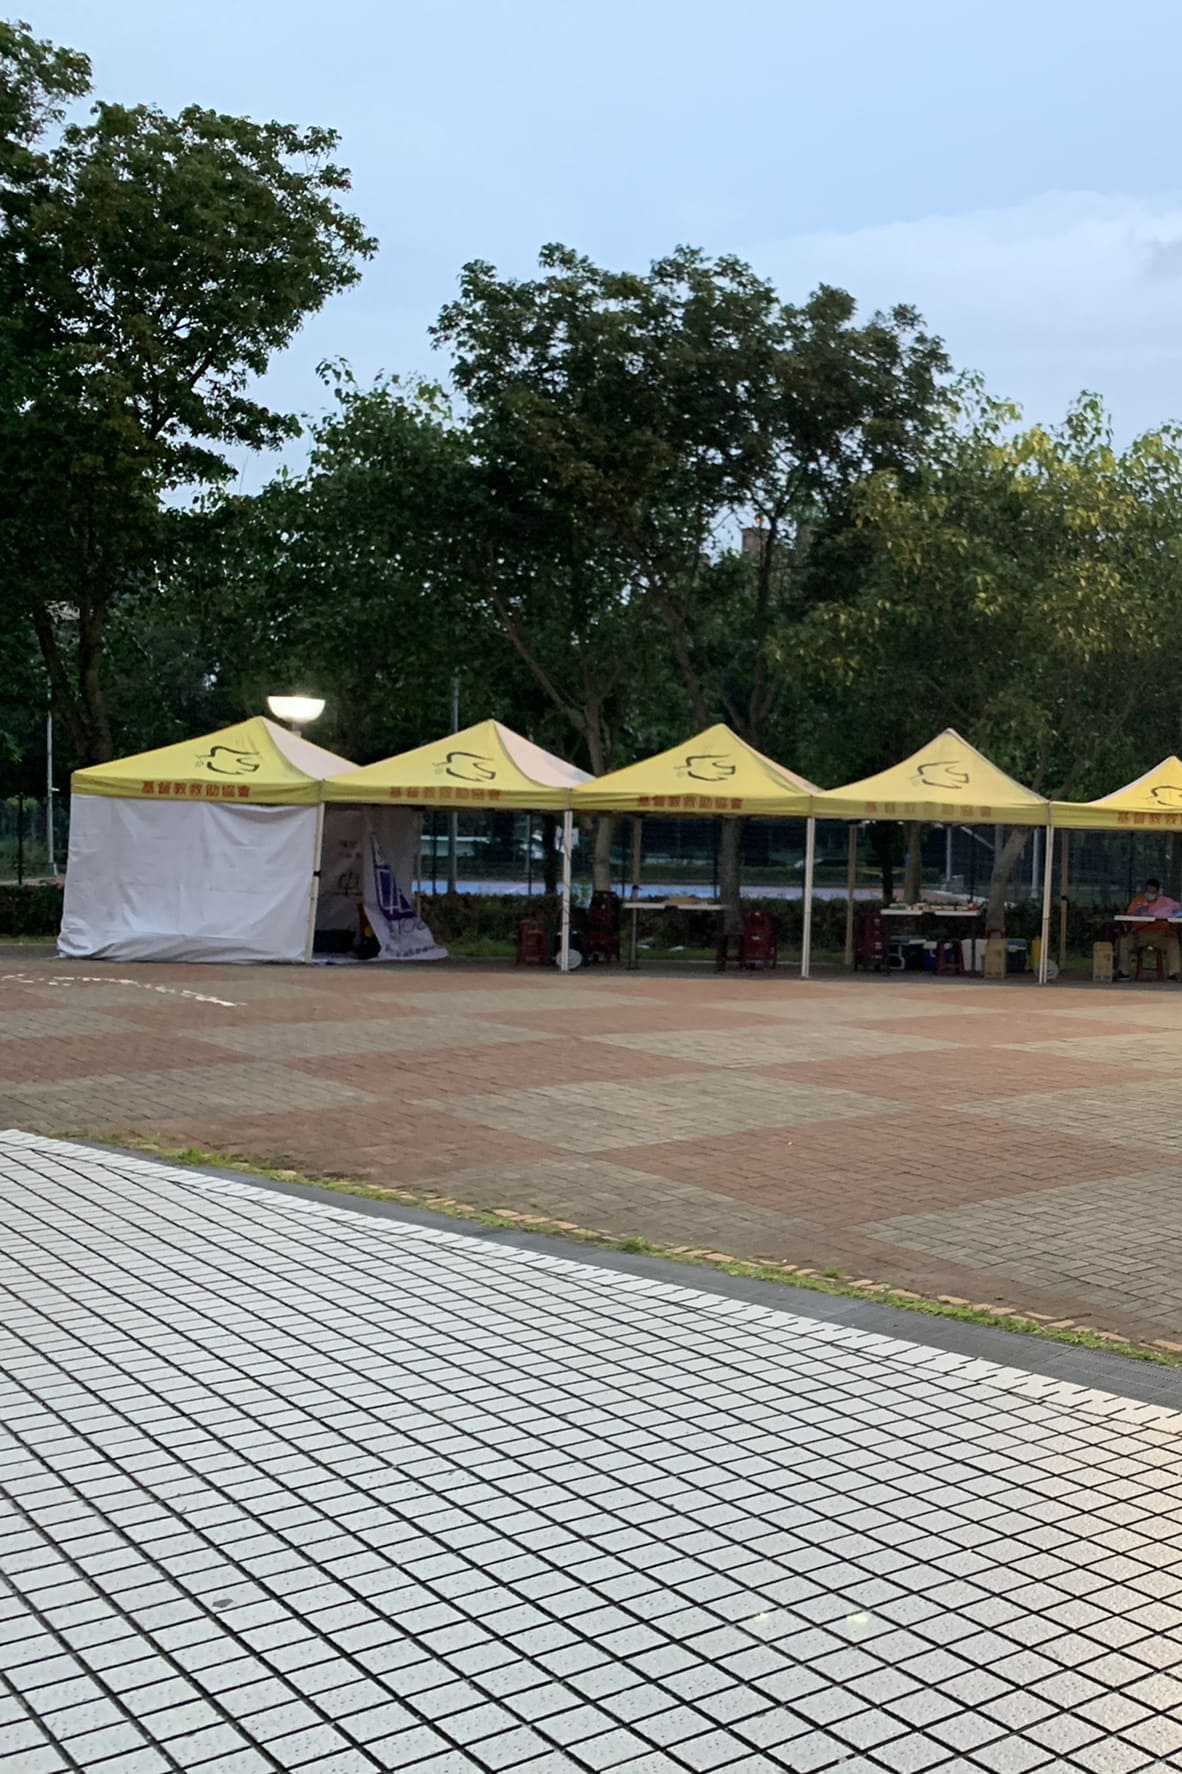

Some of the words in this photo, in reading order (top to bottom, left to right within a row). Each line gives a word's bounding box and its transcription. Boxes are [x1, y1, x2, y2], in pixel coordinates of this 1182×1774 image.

[142, 781, 250, 798] 基督教救助協會
